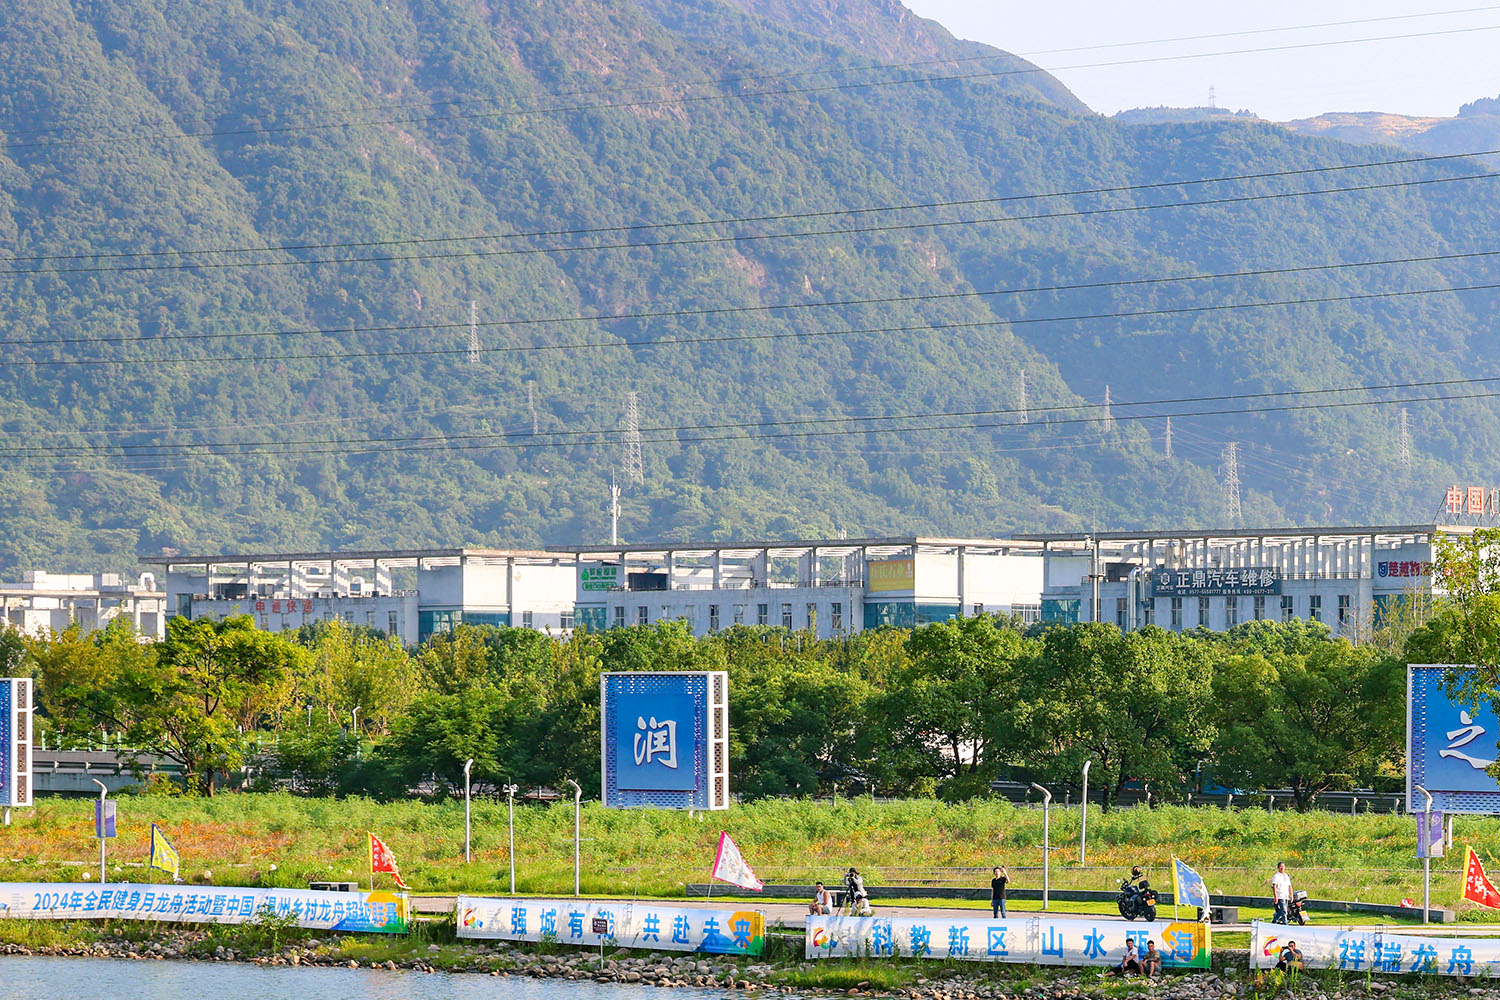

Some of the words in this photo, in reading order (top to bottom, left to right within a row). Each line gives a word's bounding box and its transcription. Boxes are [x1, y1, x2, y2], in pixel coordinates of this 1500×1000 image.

[1176, 569, 1275, 588] 正鼎汽车维修
[633, 715, 678, 769] 润
[1439, 710, 1496, 769] 之
